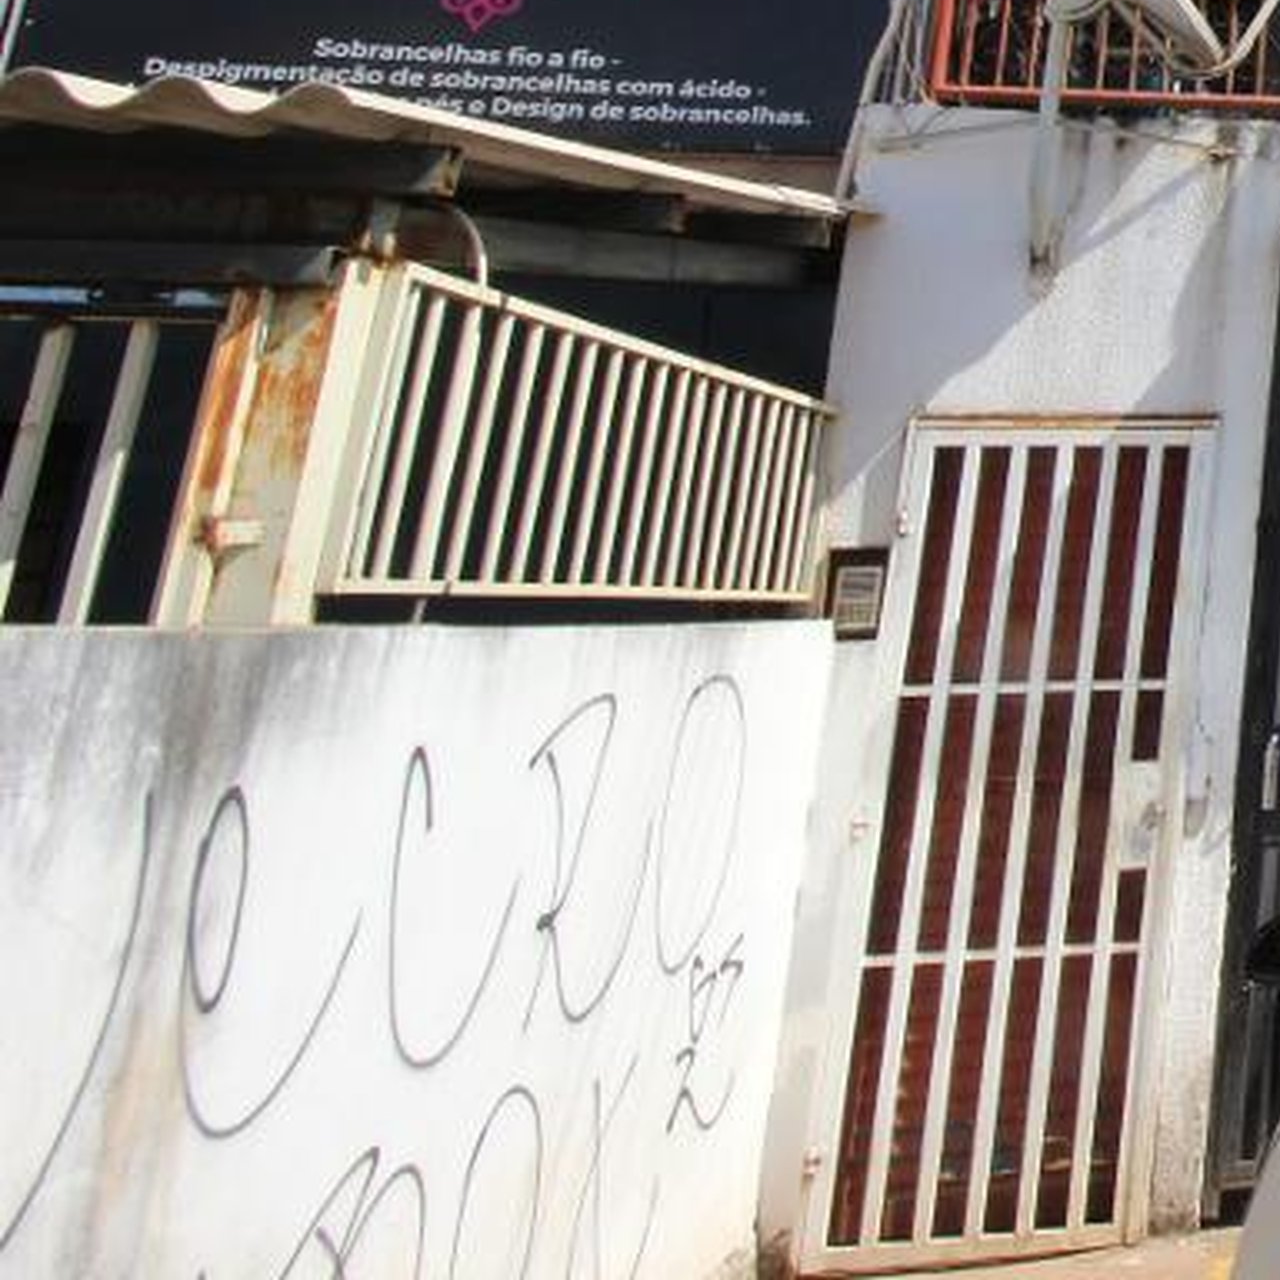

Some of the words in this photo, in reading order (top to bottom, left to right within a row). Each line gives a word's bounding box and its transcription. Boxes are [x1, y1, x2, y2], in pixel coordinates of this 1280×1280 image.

[313, 37, 500, 65] Sobrancelhas
[506, 46, 543, 68] fio
[546, 52, 563, 68] a
[570, 49, 606, 69] fio
[388, 66, 422, 88] de
[429, 69, 612, 95] sobrancelhas
[615, 78, 674, 97] com
[678, 78, 753, 99] ácido
[490, 96, 584, 122] Design
[589, 100, 624, 120] de
